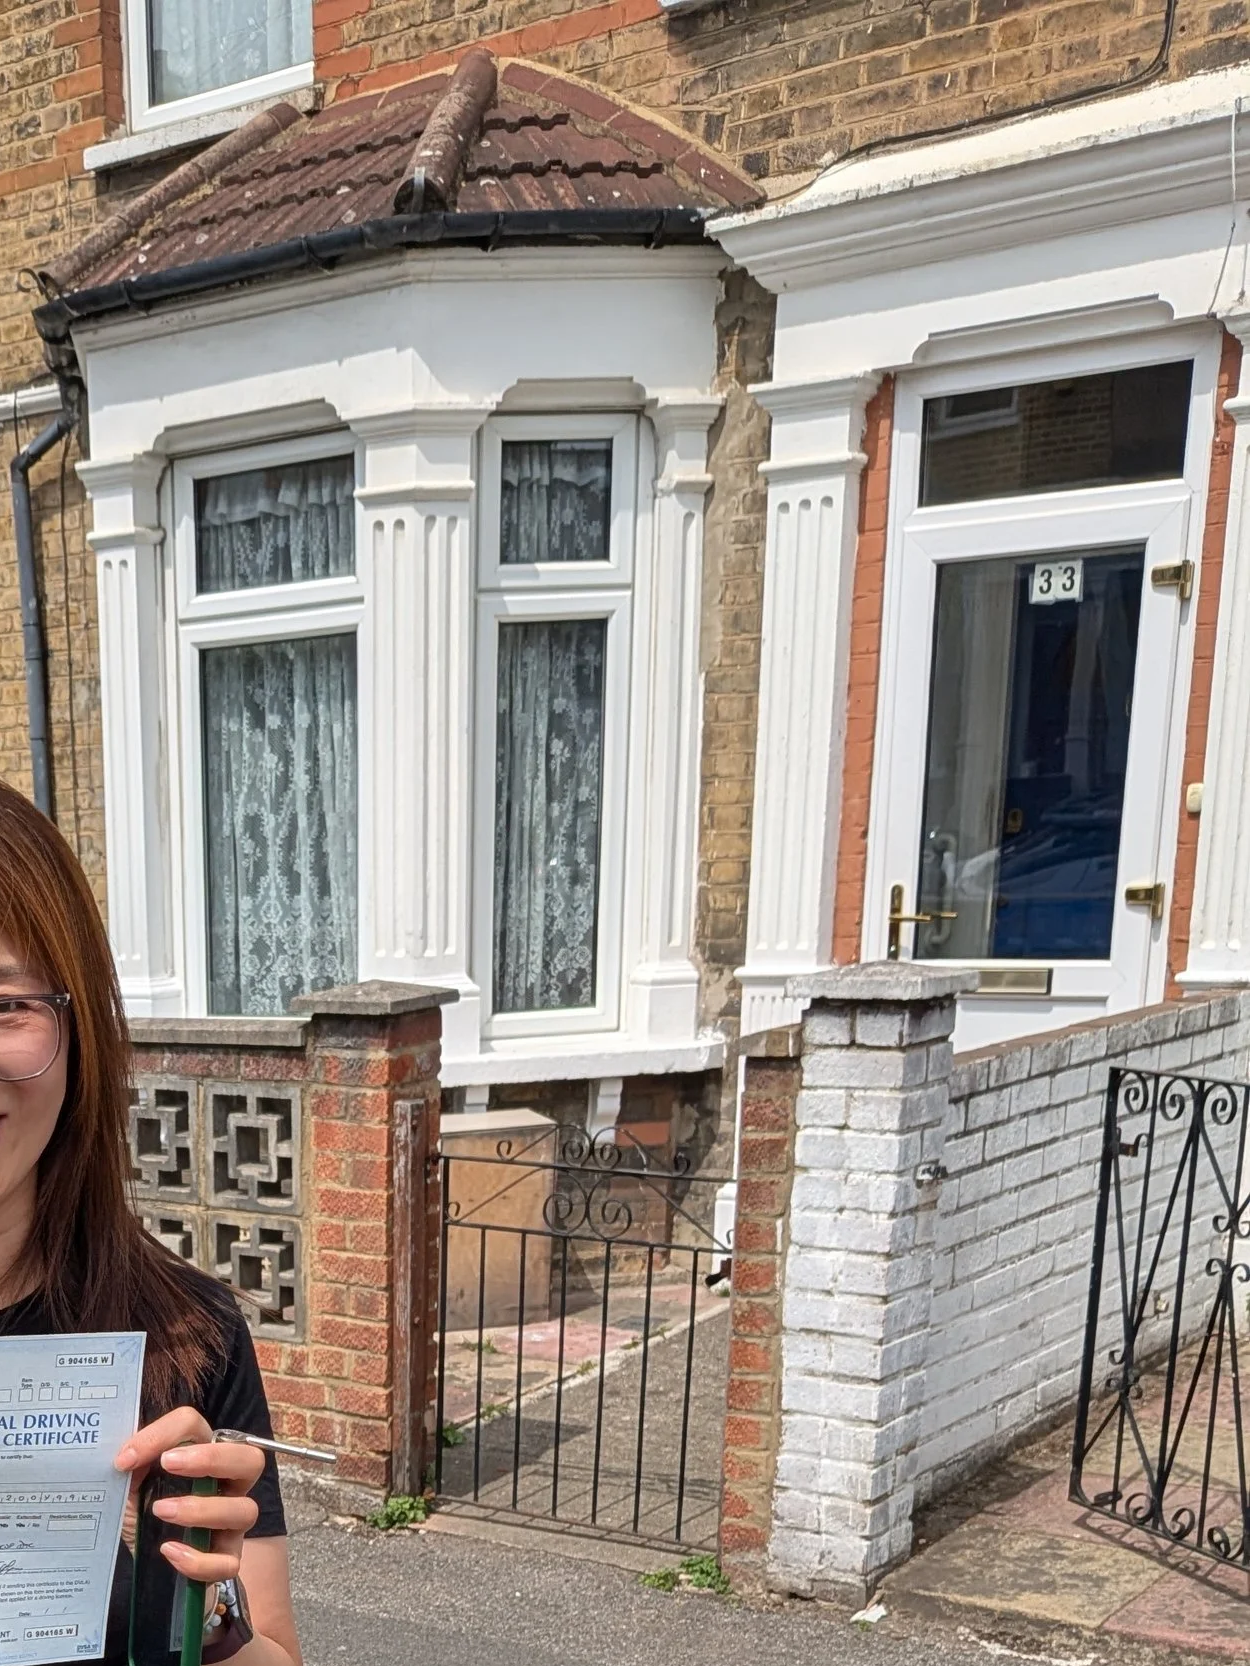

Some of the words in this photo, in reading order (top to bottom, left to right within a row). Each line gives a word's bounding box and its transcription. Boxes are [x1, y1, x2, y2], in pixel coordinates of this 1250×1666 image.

[1039, 566, 1076, 594] 33
[23, 1412, 100, 1428] DRIVING
[3, 1431, 99, 1446] CERTIFICATE
[35, 1628, 64, 1637] 904165
